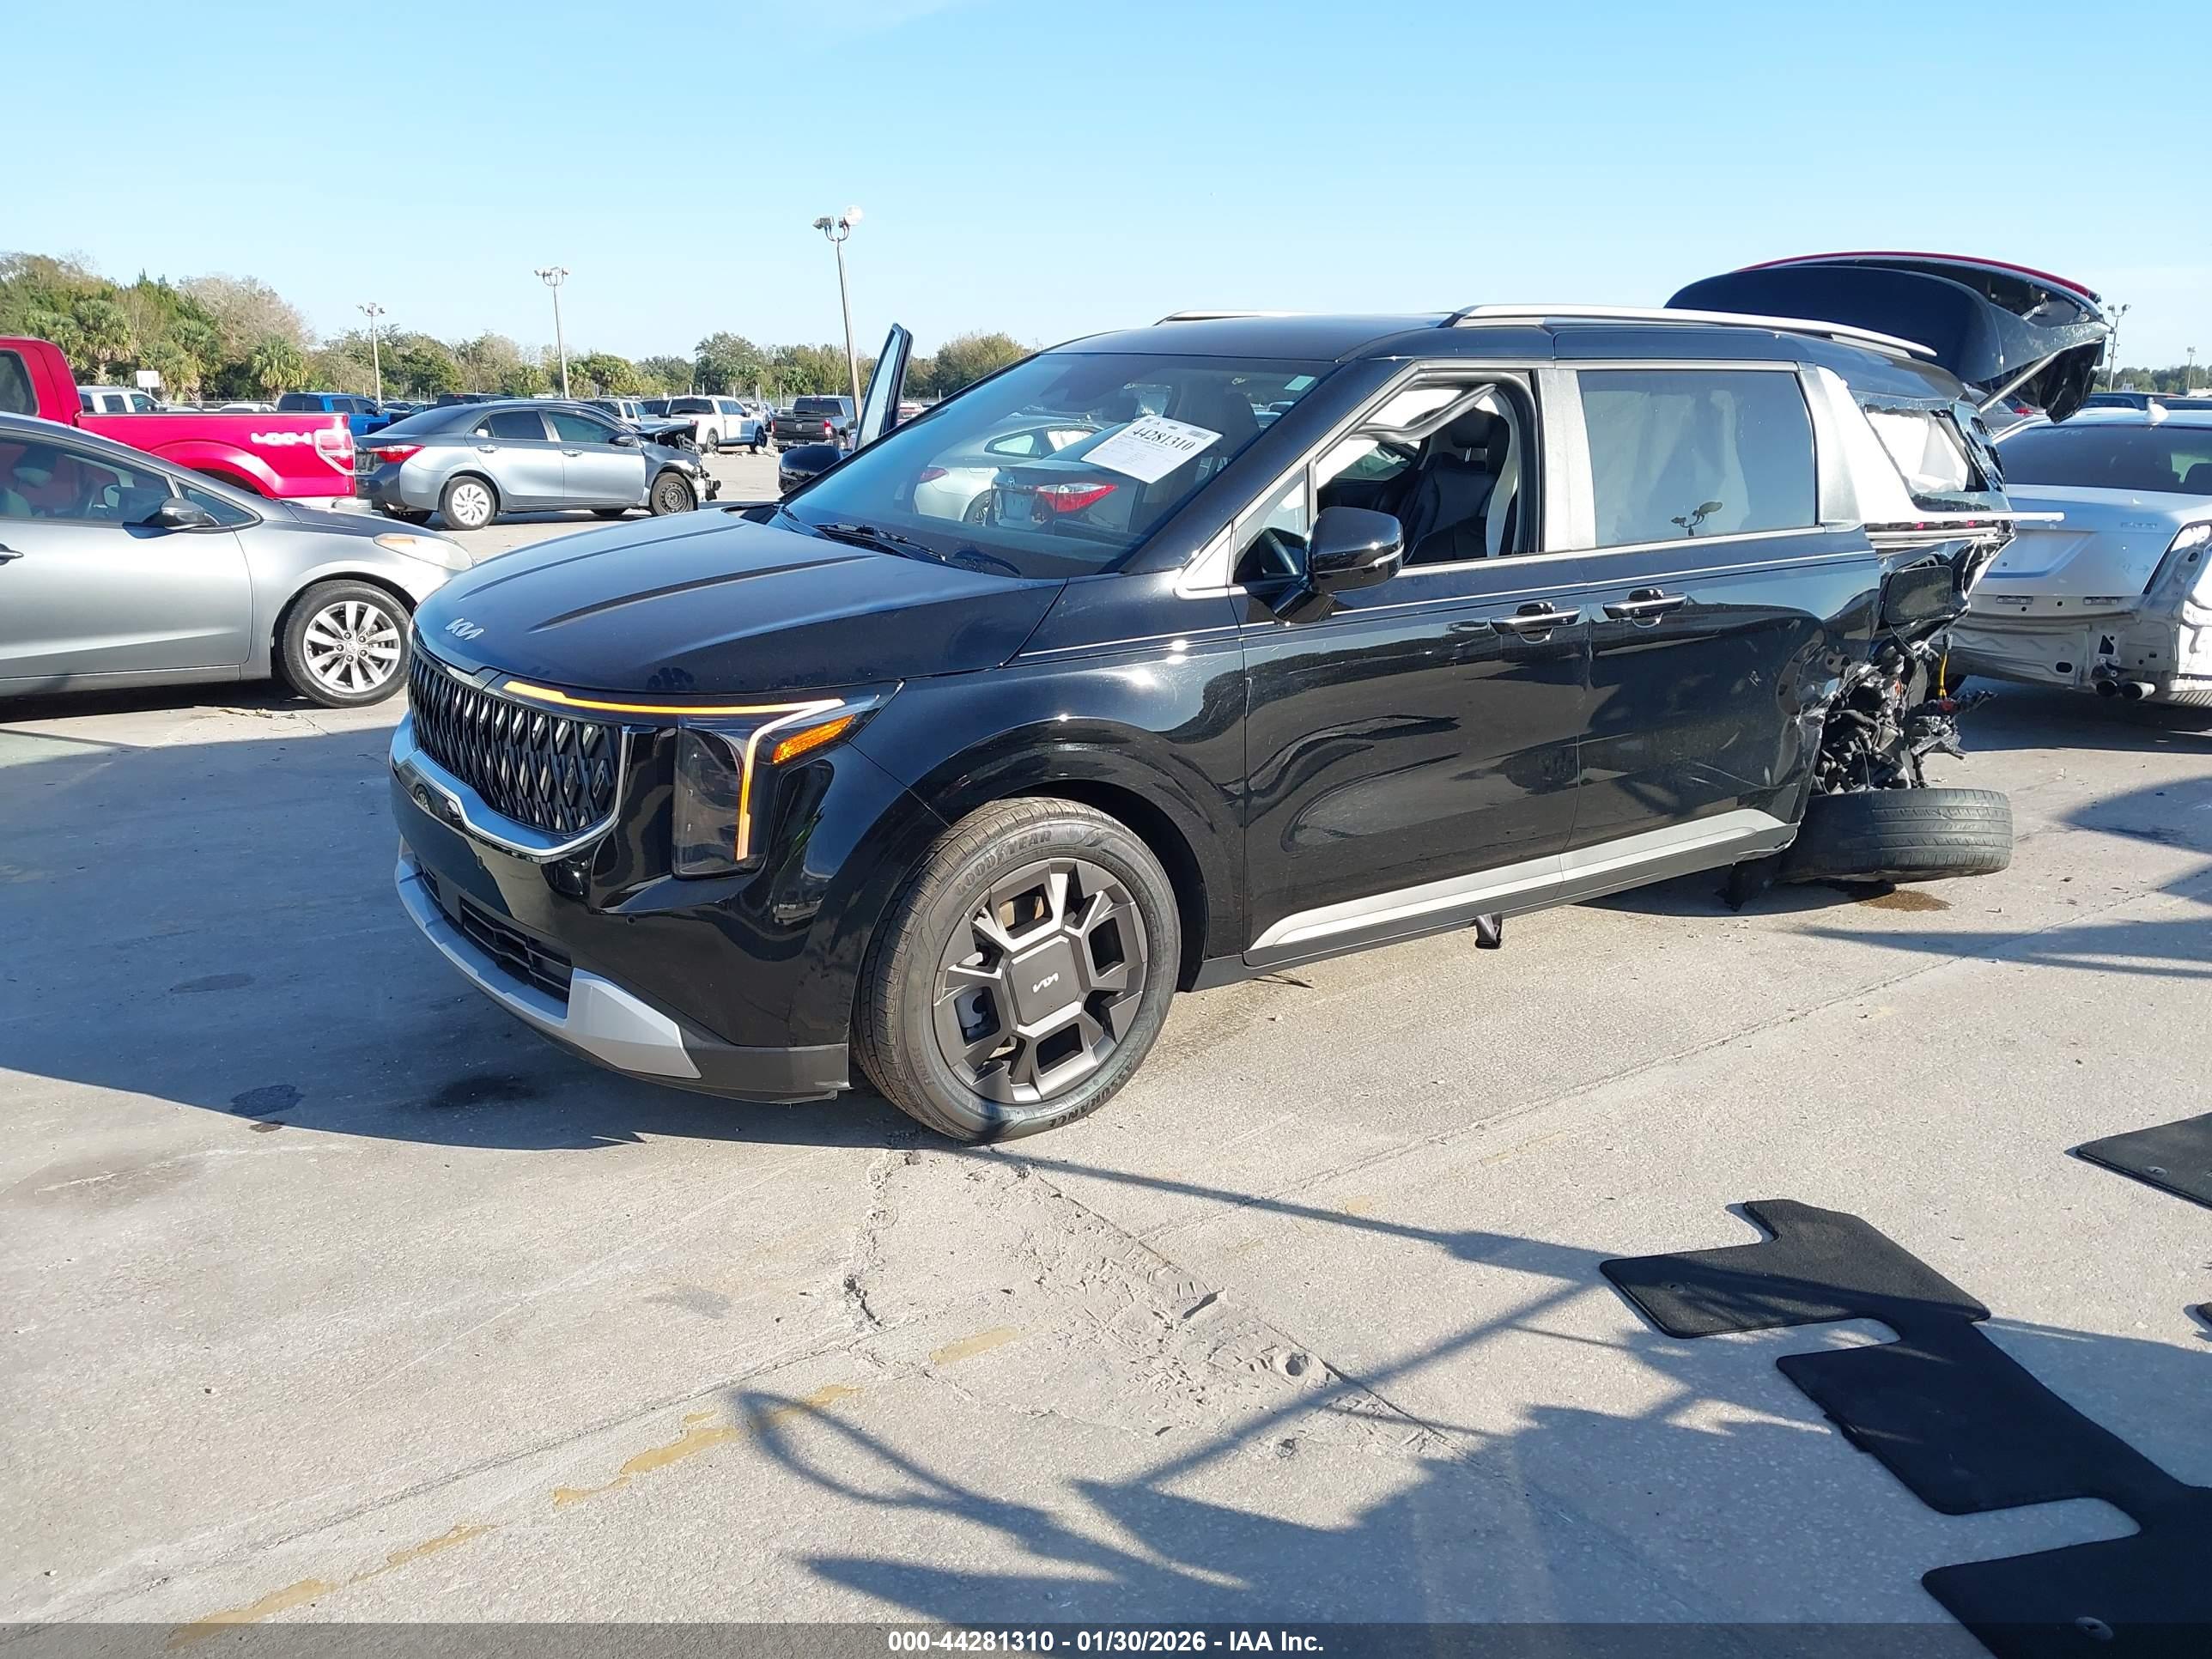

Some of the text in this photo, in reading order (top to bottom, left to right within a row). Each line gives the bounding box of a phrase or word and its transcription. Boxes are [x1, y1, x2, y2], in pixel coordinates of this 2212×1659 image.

[1133, 427, 1196, 452] 44281310
[445, 617, 484, 641] KIA
[954, 830, 1052, 896] GOODYEAR
[1048, 1060, 1133, 1128] ASSURANCE
